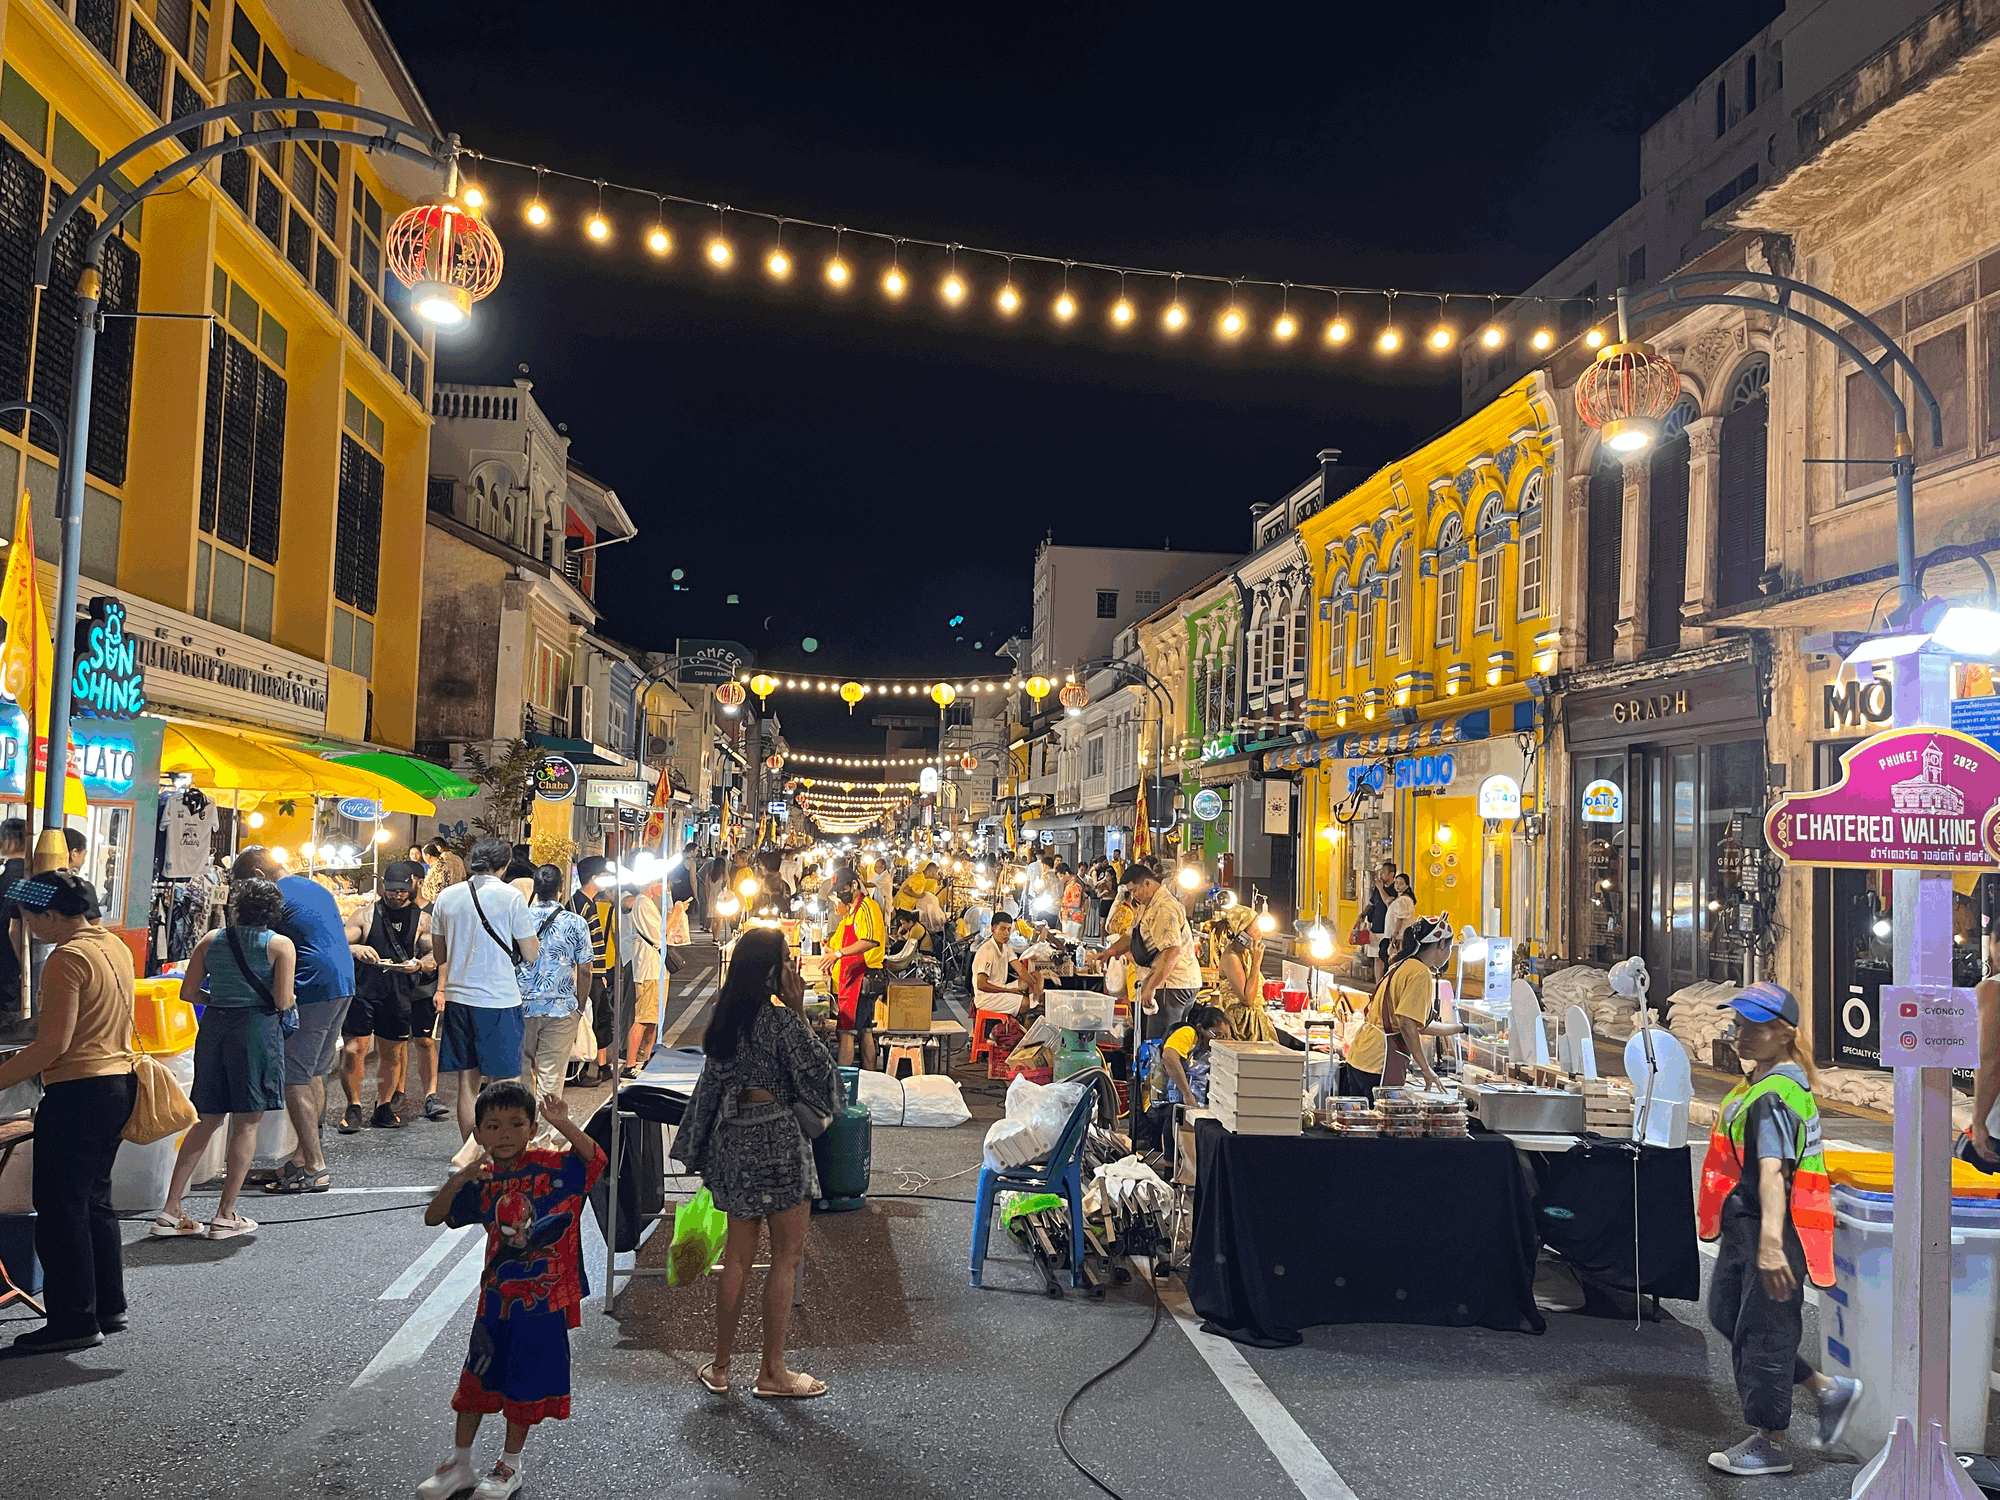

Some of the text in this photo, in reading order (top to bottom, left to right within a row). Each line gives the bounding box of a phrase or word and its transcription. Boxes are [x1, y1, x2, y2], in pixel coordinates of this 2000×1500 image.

[90, 626, 135, 677] SUN
[73, 660, 145, 714] SHINE
[1613, 689, 1688, 724] GRAPH
[1395, 753, 1453, 788] STUDIO
[1878, 750, 1979, 773] PHUKET 2022
[538, 781, 569, 790] Chaba
[1796, 813, 1976, 846] CHATERED WALKING
[1717, 857, 1740, 866] GRAP
[1924, 1007, 1965, 1016] GYONGYO
[1842, 1045, 1871, 1058] SPECIALTY
[1924, 1038, 1965, 1046] GYOTORD
[480, 1173, 553, 1213] SPIDER
